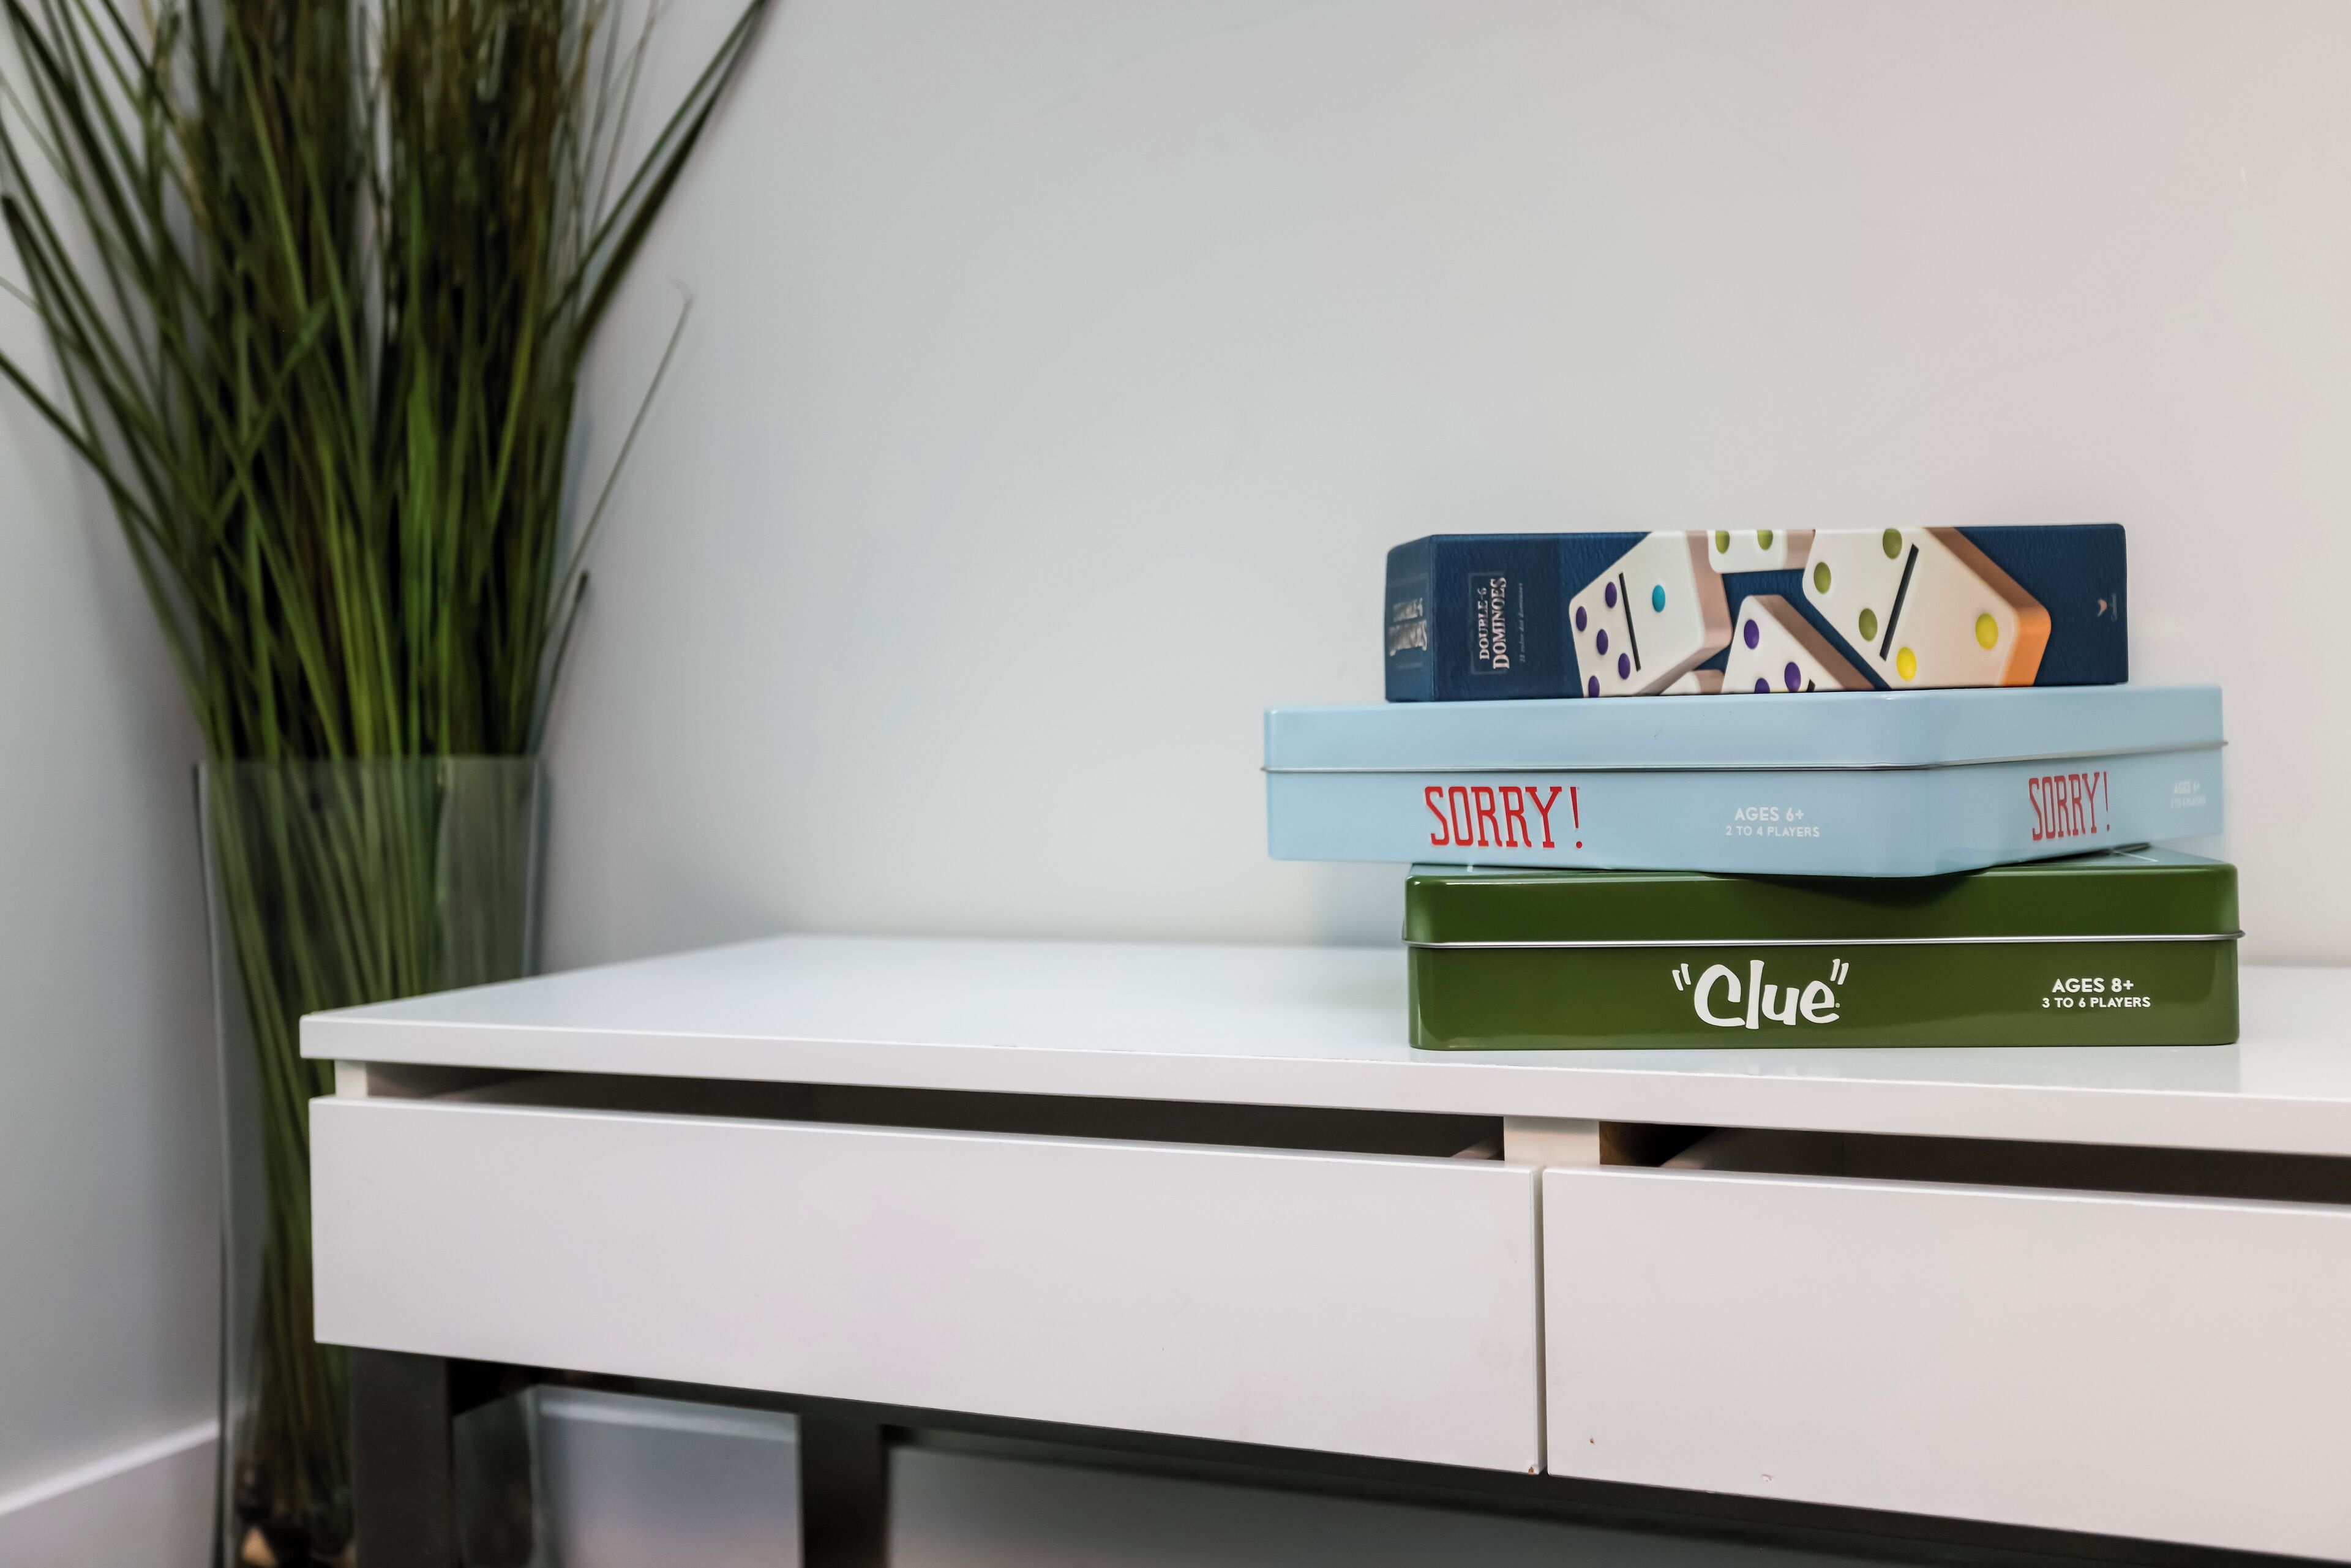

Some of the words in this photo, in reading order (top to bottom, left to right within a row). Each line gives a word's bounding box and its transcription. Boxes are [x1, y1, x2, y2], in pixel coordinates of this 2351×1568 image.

[1477, 587, 1490, 660] DOUBLE-6
[1490, 577, 1510, 669] DOMINOES
[1424, 786, 1583, 849] SORRY!
[1734, 806, 1780, 822] AGES
[1785, 807, 1804, 822] 6+
[2028, 771, 2110, 841] SORRY!
[1725, 825, 1732, 836] 2
[1736, 825, 1752, 836] TO
[1756, 826, 1763, 836] 4
[1767, 826, 1820, 838] PLAYERS
[2042, 997, 2050, 1008] 3
[2054, 997, 2074, 1008] TO
[2078, 997, 2086, 1008] 6
[2090, 996, 2151, 1008] PLAYERS
[2052, 977, 2105, 993] AGES
[2111, 977, 2134, 992] 8+
